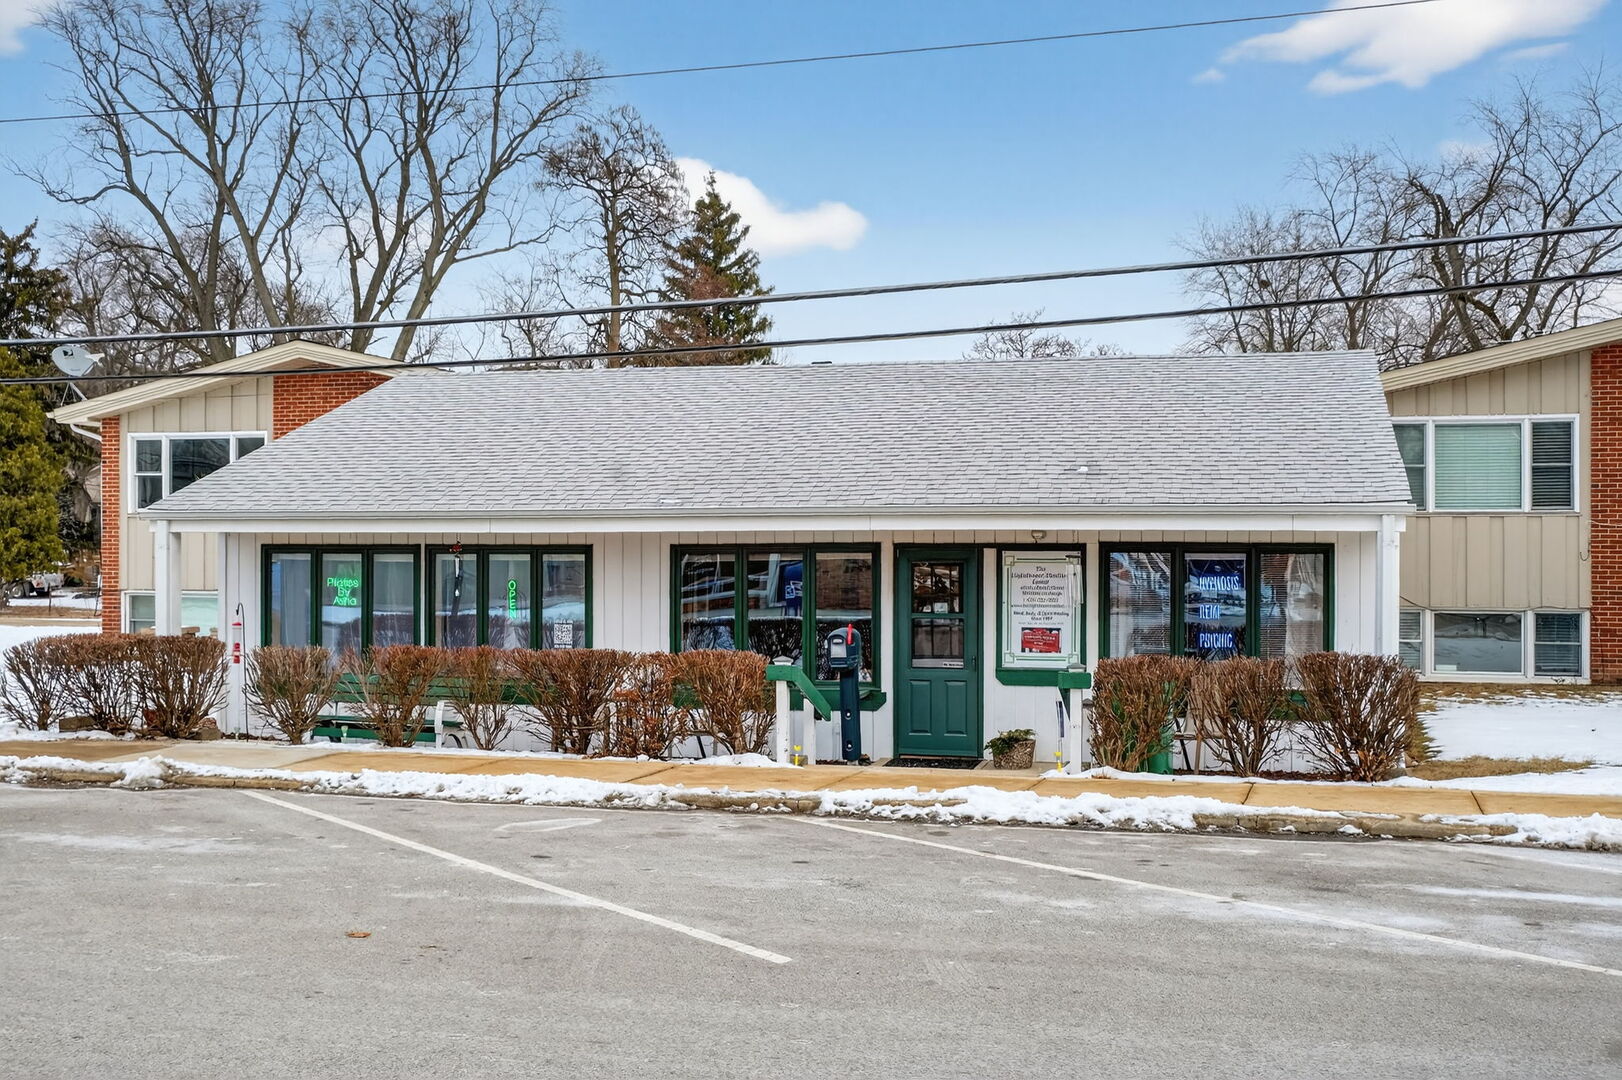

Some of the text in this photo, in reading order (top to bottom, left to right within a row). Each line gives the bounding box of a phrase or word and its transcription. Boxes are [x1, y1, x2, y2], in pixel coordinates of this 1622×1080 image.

[1199, 575, 1240, 591] HYPNOSIS
[508, 580, 517, 619] OPEN
[1199, 604, 1221, 620] REIKI
[1199, 632, 1233, 649] PSYCHIC
